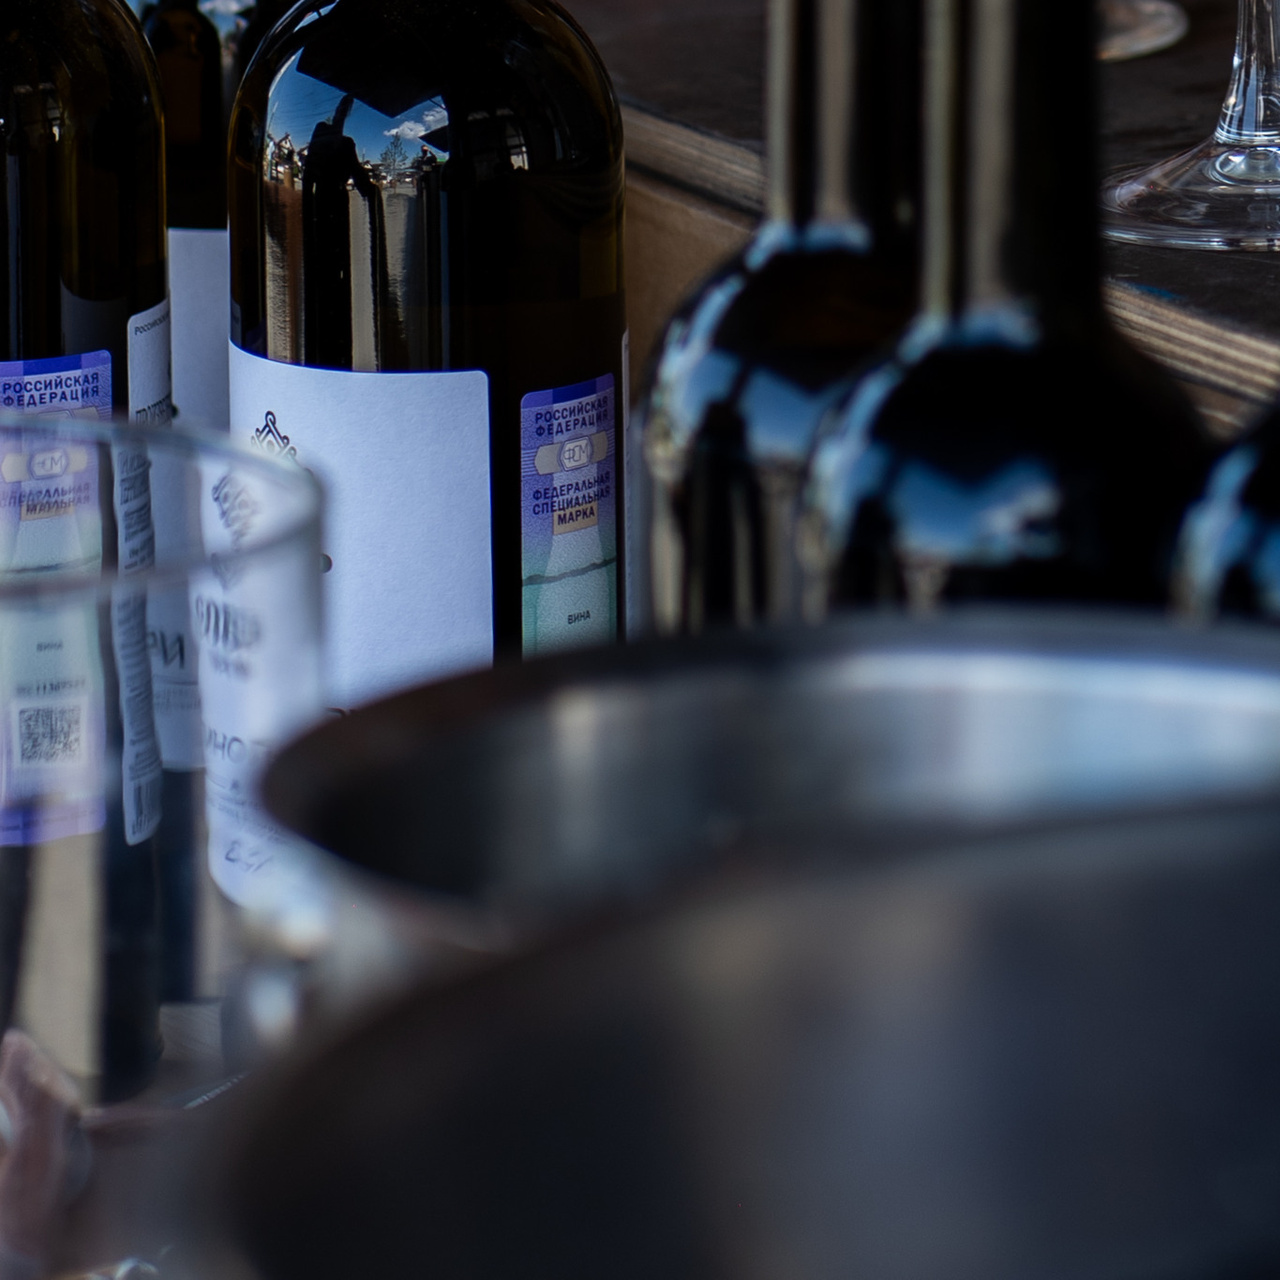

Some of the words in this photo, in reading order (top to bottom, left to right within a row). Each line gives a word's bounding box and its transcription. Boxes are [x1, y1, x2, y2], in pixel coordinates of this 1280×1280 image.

[3, 371, 99, 394] РОССИЙСКАЯ
[3, 385, 99, 407] ФЕДЕРАЦИЯ
[535, 395, 608, 424] РОССИЙСКАЯ
[535, 408, 608, 437] ФЕДЕРАЦИЯ
[532, 471, 610, 502] ФЕДЕРАЛЬНАЯ
[533, 485, 610, 515] СПЕЦИАЛЬНАЯ
[557, 505, 596, 525] МАРКА
[567, 609, 591, 625] ВИНА
